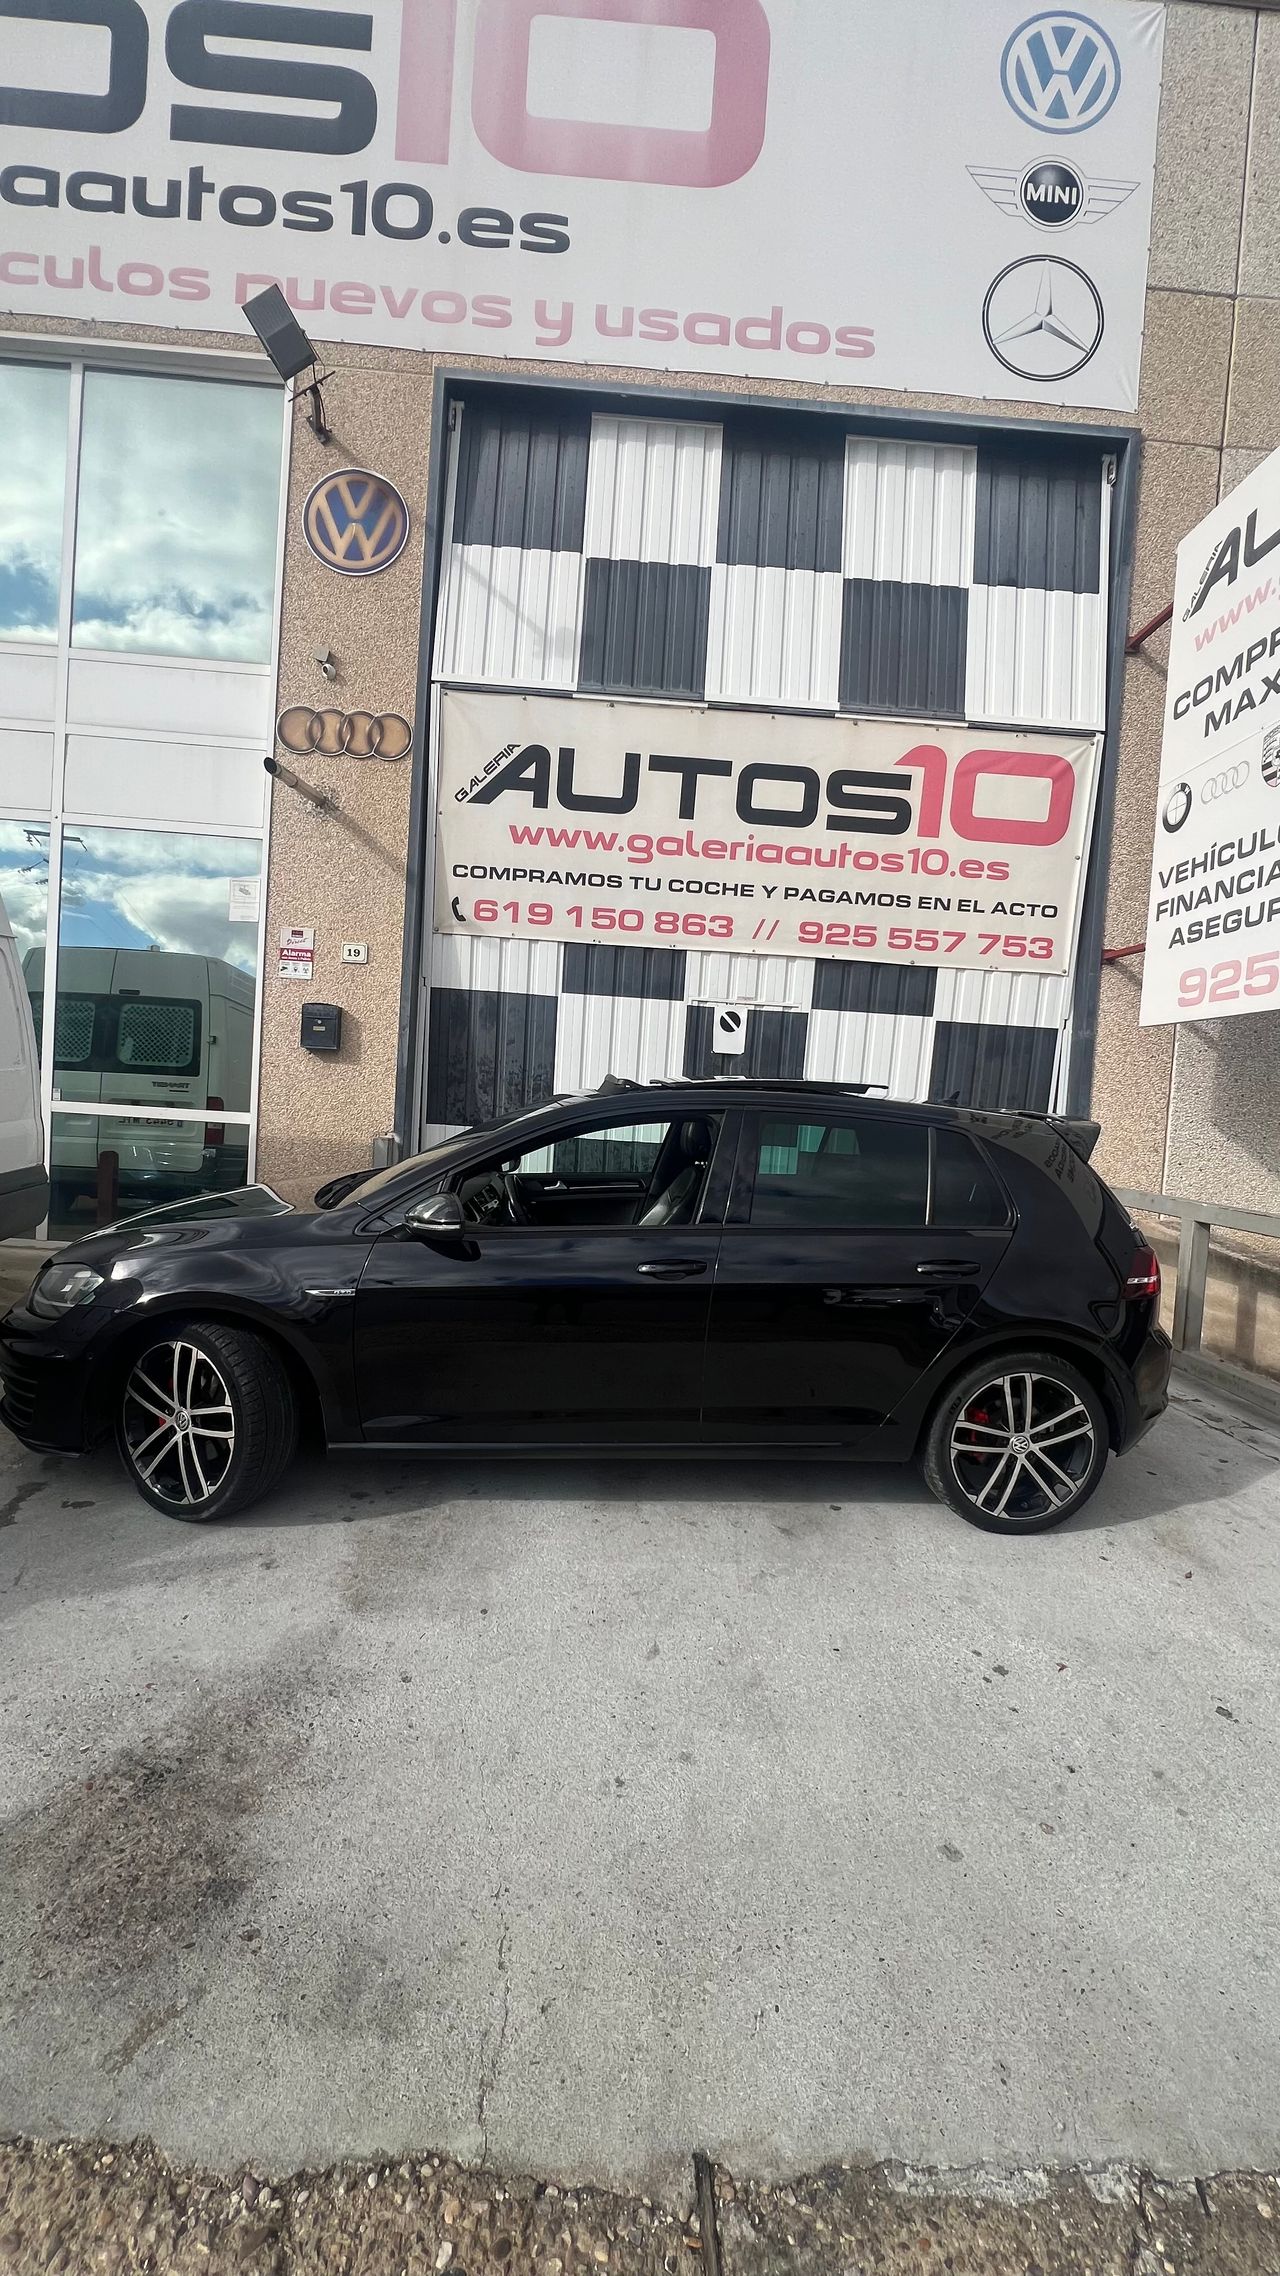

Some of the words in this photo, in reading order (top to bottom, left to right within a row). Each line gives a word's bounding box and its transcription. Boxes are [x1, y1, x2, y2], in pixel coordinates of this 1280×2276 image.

[0, 165, 570, 254] aautos10.es
[1026, 182, 1078, 207] MINI
[235, 272, 513, 329] nuevos
[534, 299, 573, 346] y
[594, 304, 876, 359] usados
[1182, 541, 1223, 622] GALERIA
[1194, 576, 1280, 652] www.
[454, 743, 522, 803] GALERIA
[466, 744, 1075, 847] AUTOS10
[509, 823, 1010, 881] www.galeriaautos10.es
[1158, 825, 1280, 889] VEHÍCUL
[452, 864, 623, 888] COMPRAMOS
[629, 876, 662, 891] TU
[668, 879, 755, 898] COCHE
[761, 885, 778, 899] Y
[784, 887, 911, 908] PAGAMOS
[917, 896, 951, 911] EN
[957, 899, 985, 914] EL
[990, 901, 1058, 919] ACTO
[282, 949, 312, 957] Alarma
[347, 949, 360, 957] 19
[473, 899, 553, 926] 619
[566, 905, 644, 932] 150
[654, 911, 734, 938] 863
[798, 921, 877, 948] 925
[887, 927, 967, 953] 557
[977, 933, 1054, 959] 753
[1177, 950, 1280, 1008] 925
